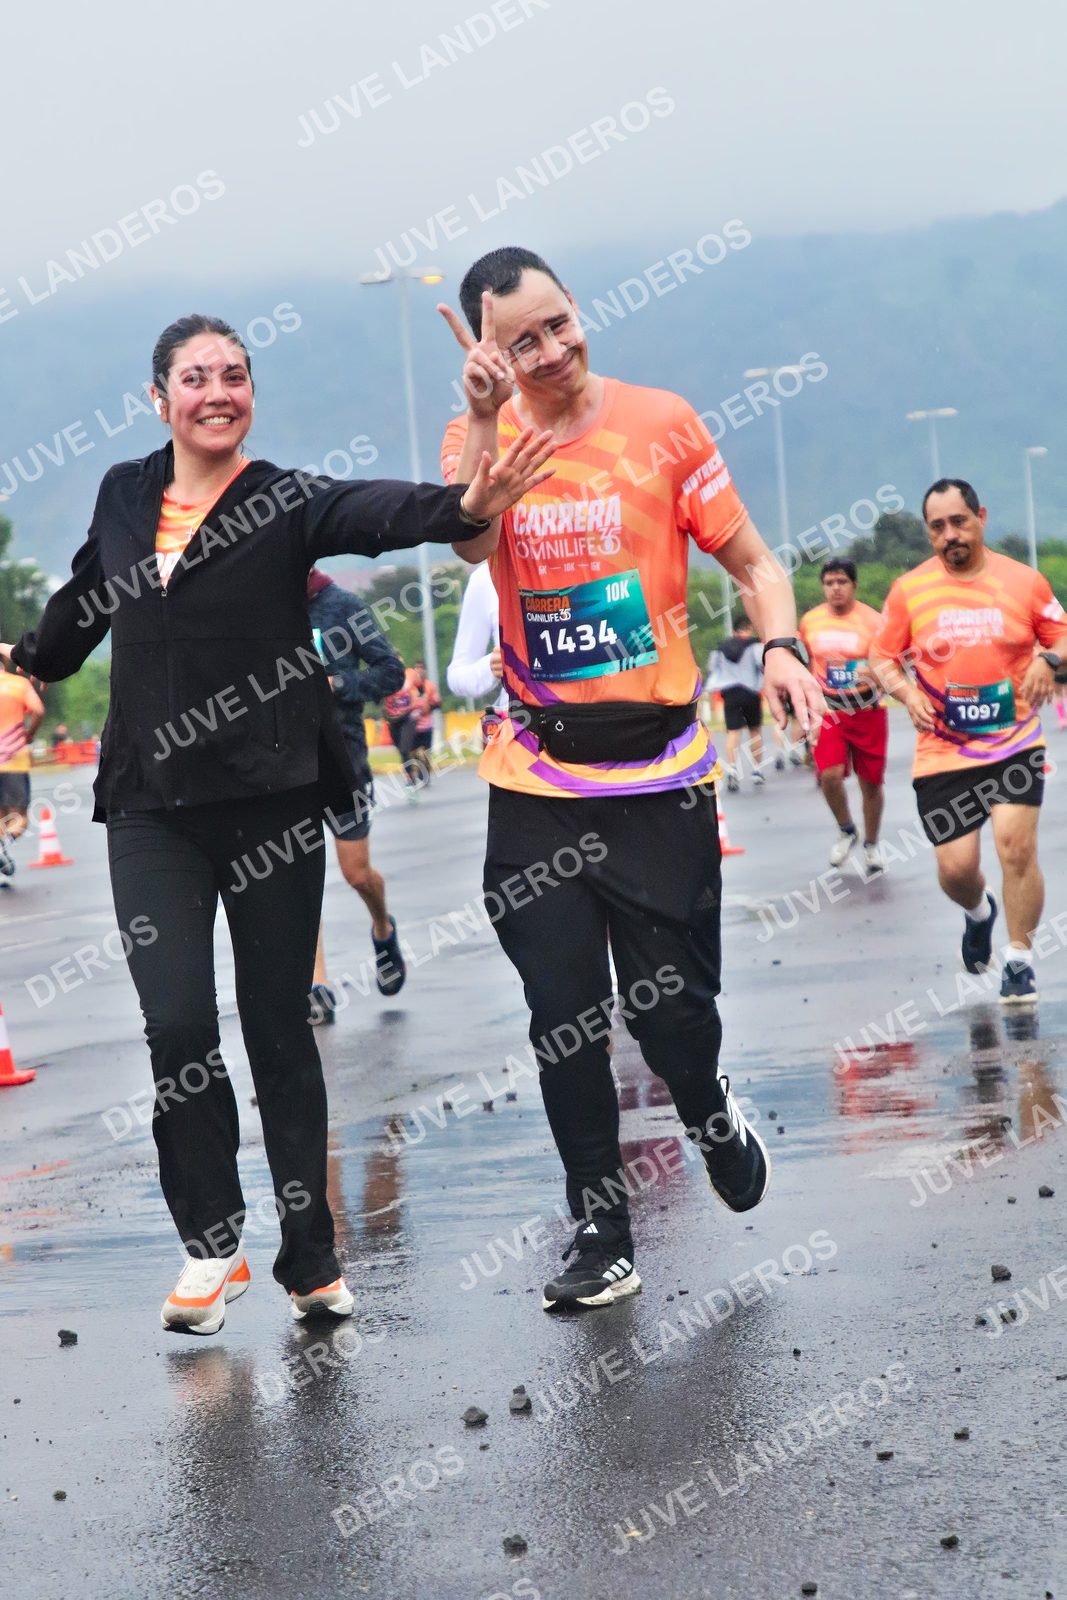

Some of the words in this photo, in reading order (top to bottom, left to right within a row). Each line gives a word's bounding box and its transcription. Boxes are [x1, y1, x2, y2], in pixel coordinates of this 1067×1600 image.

[513, 496, 622, 537] CARRERA
[604, 580, 630, 603] 10K
[525, 595, 570, 613] CARRERA
[539, 619, 618, 656] 1434
[957, 702, 1001, 721] 1097
